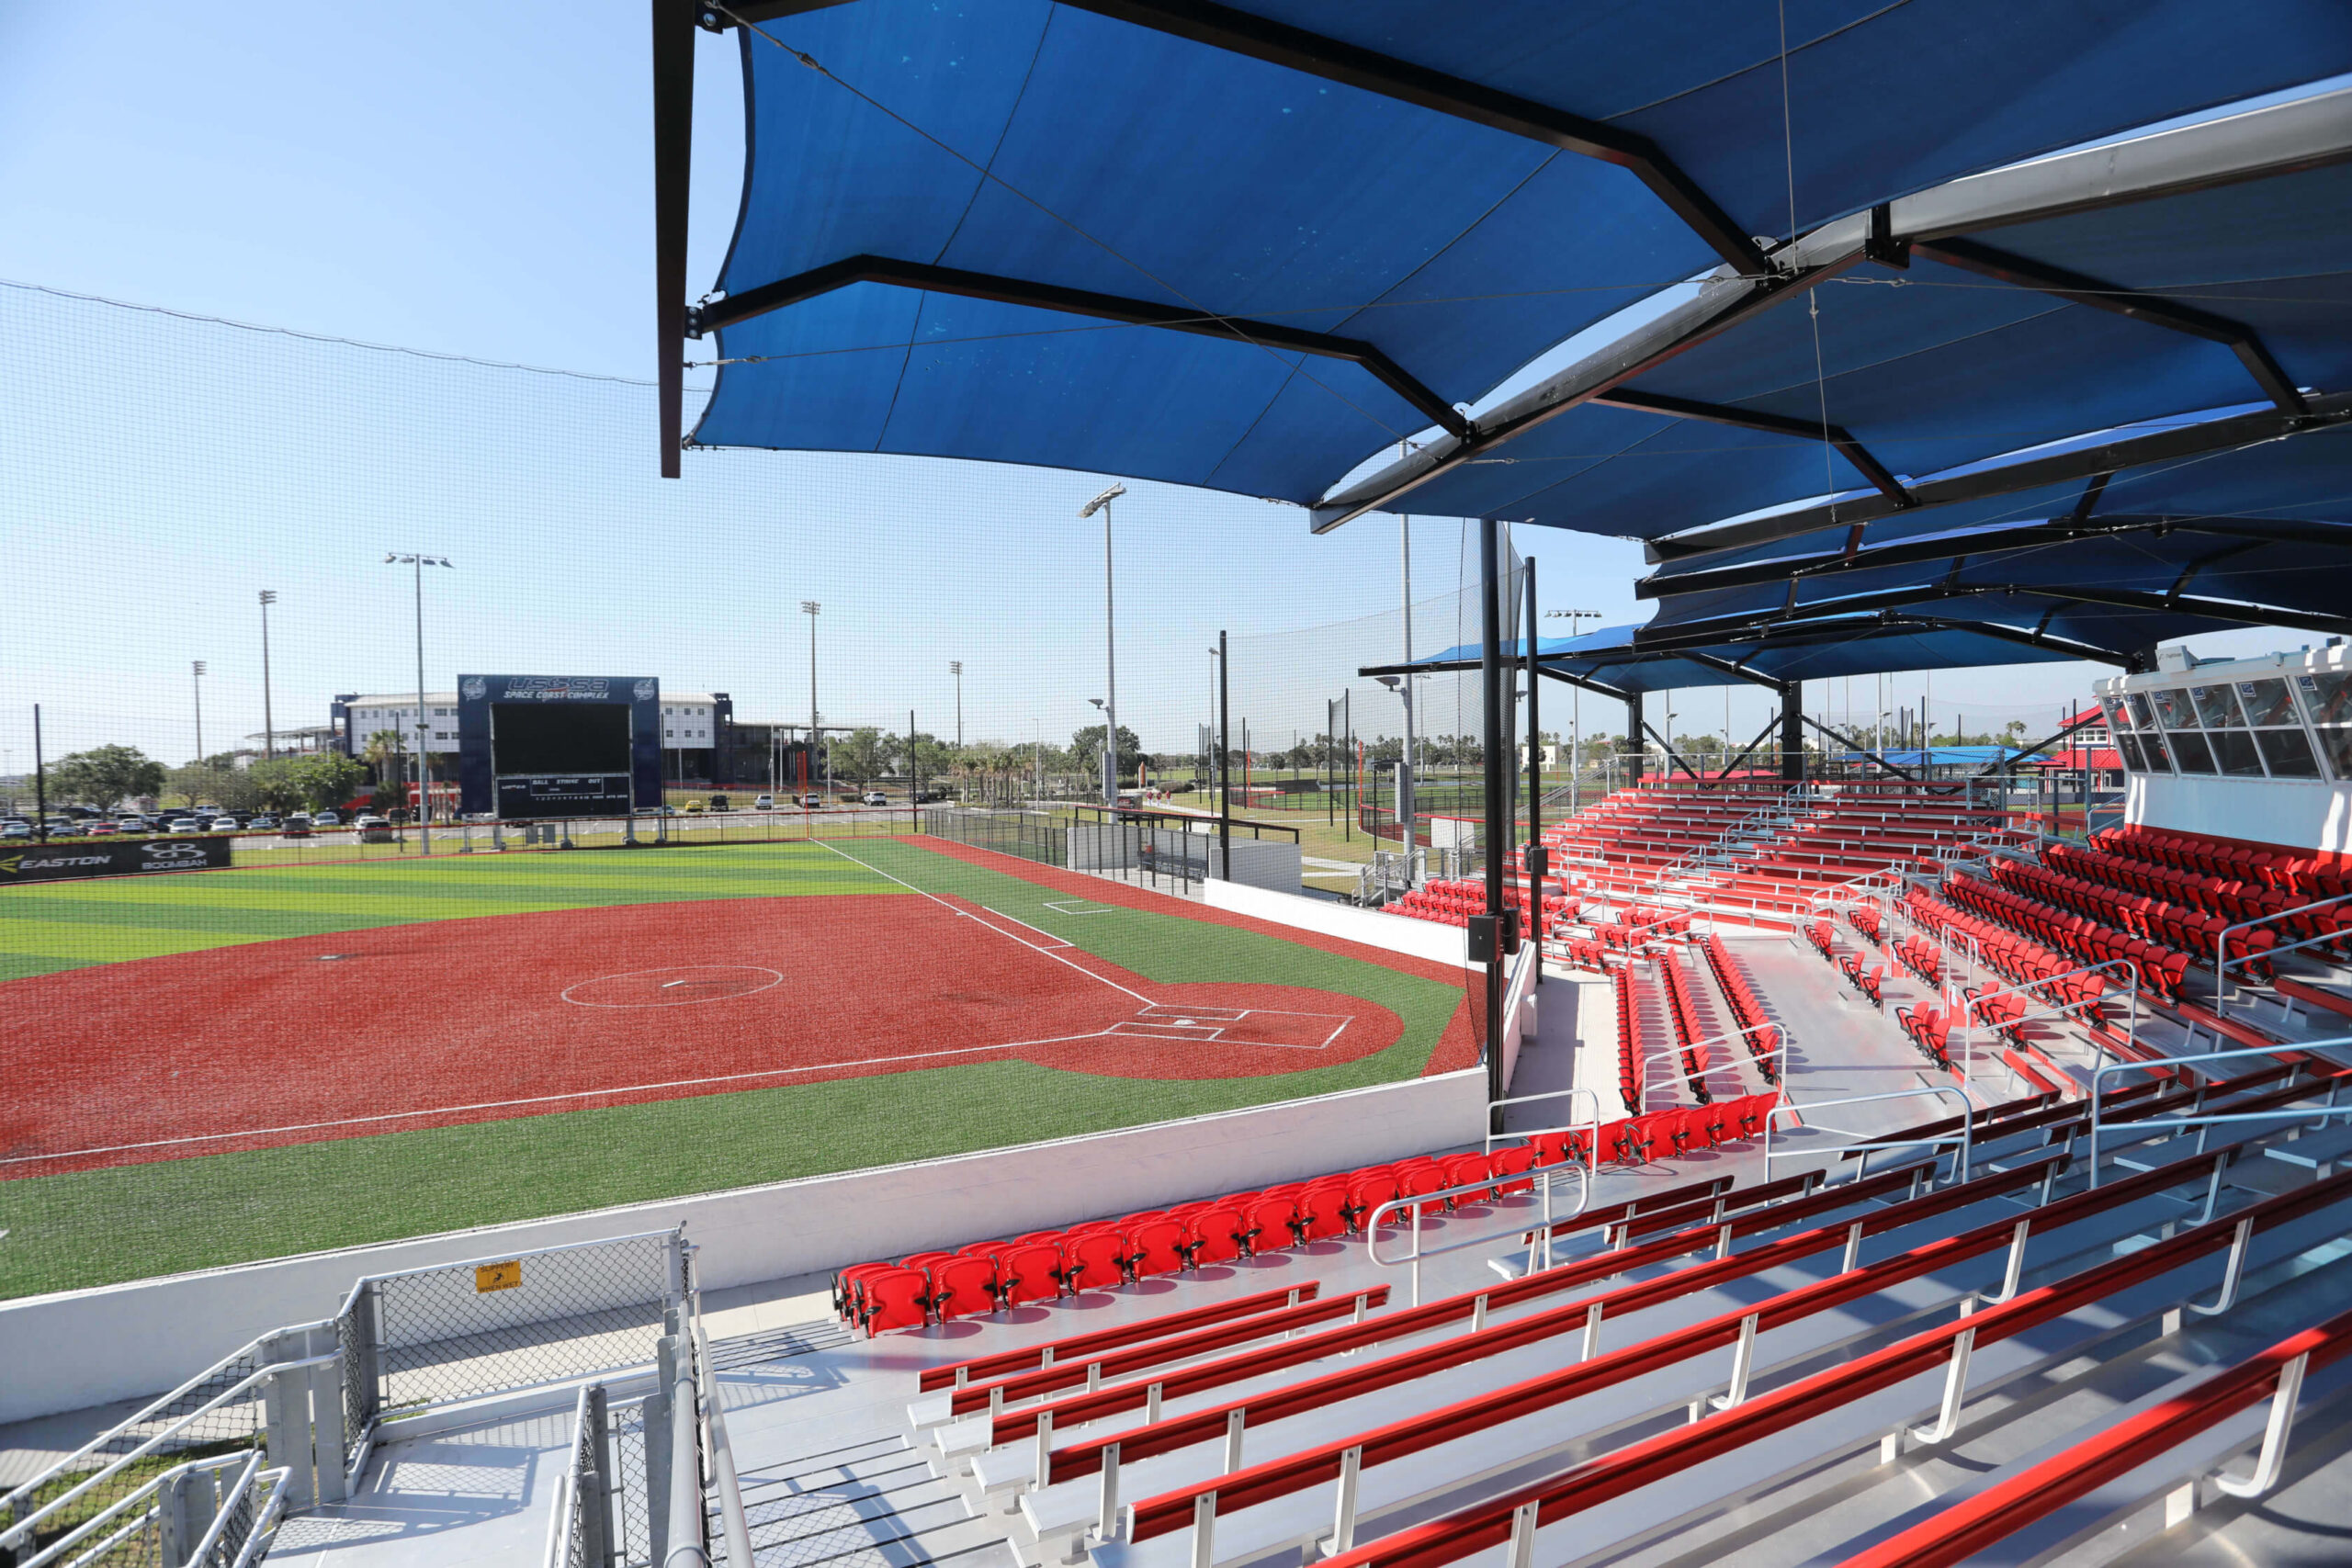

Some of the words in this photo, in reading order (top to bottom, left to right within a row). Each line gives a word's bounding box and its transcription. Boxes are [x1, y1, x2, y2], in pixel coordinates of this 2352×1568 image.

[503, 691, 533, 699] SPACE
[536, 691, 566, 699] COAST
[567, 691, 609, 699] COMPLEX
[19, 855, 112, 869] EASTON
[141, 859, 208, 870] BOOMBAH
[481, 1262, 514, 1272] SLIPPERY
[503, 1280, 518, 1289] WET
